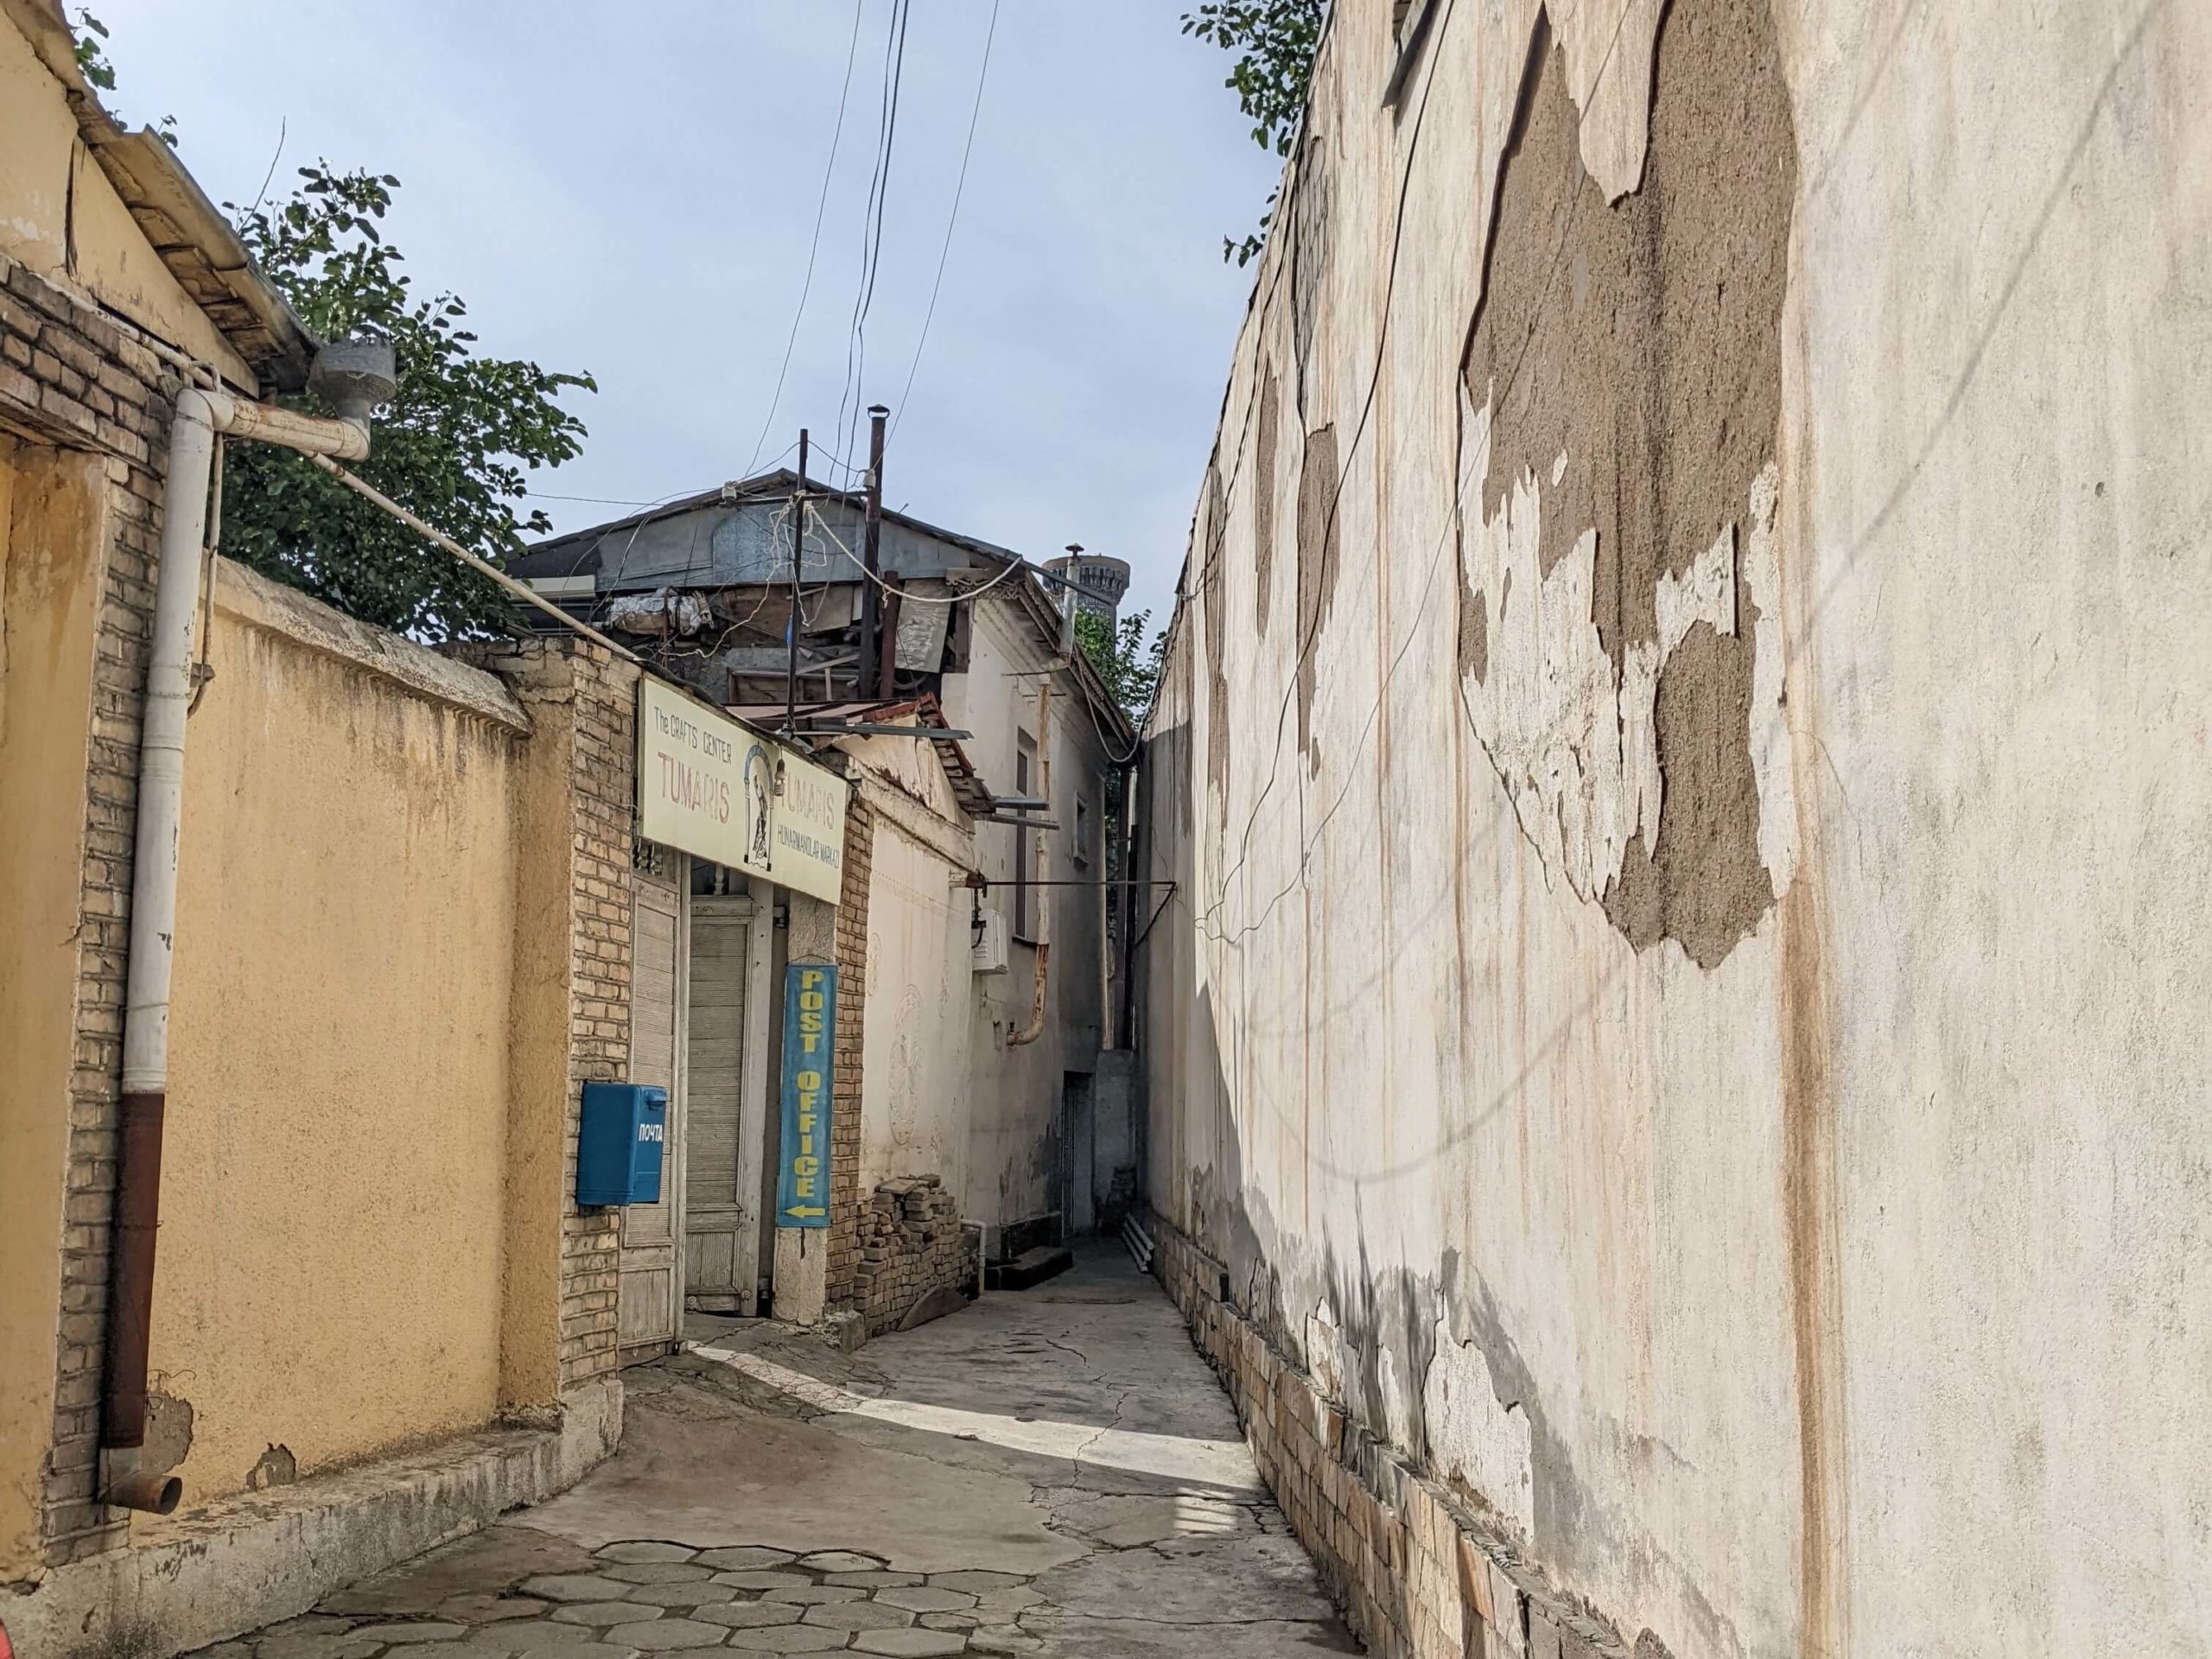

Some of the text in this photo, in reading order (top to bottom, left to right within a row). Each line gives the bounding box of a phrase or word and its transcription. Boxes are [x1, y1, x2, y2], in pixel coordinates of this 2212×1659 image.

[654, 706, 732, 766] The CRAFTS CENTER
[658, 751, 730, 824] TUMARIS
[794, 969, 824, 1198] POST OFFICE
[639, 1123, 664, 1142] ПОЧТА
